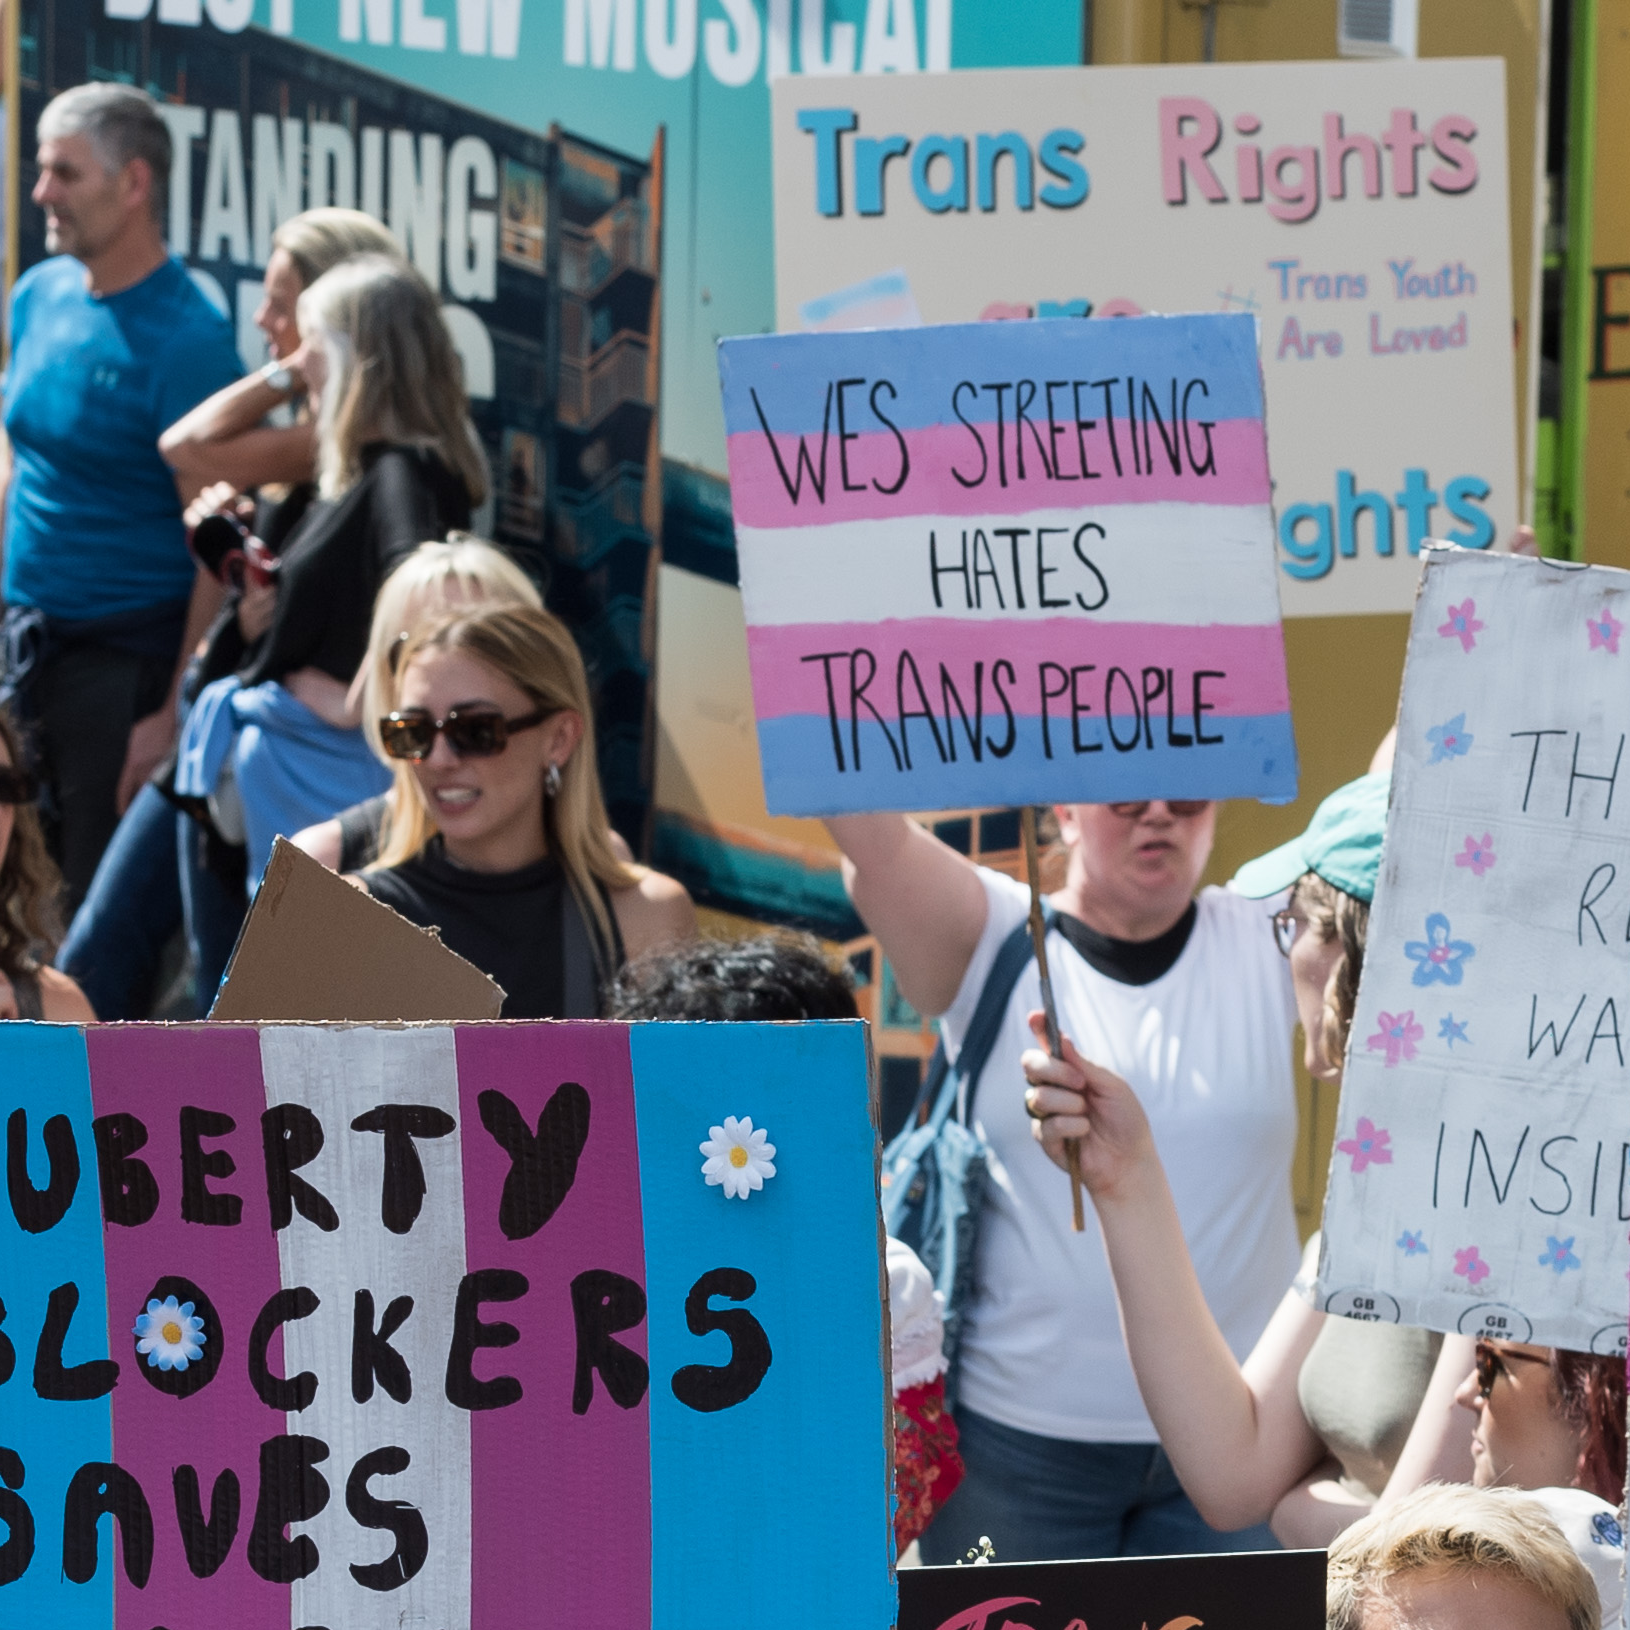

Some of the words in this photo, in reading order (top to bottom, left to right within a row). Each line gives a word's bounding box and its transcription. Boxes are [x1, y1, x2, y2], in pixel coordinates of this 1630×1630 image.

[798, 108, 1090, 216] Trans
[1158, 96, 1479, 222] Rights
[1268, 258, 1368, 302] Trans
[1386, 256, 1476, 300] Youth
[1276, 316, 1344, 360] Are
[1369, 311, 1470, 357] Loved
[750, 378, 910, 506] WES
[951, 376, 1217, 488] STREETING
[930, 522, 1109, 611] HATES
[1270, 468, 1495, 580] ghts
[800, 648, 1017, 772] TRANS
[1038, 664, 1226, 759] PEOPLE
